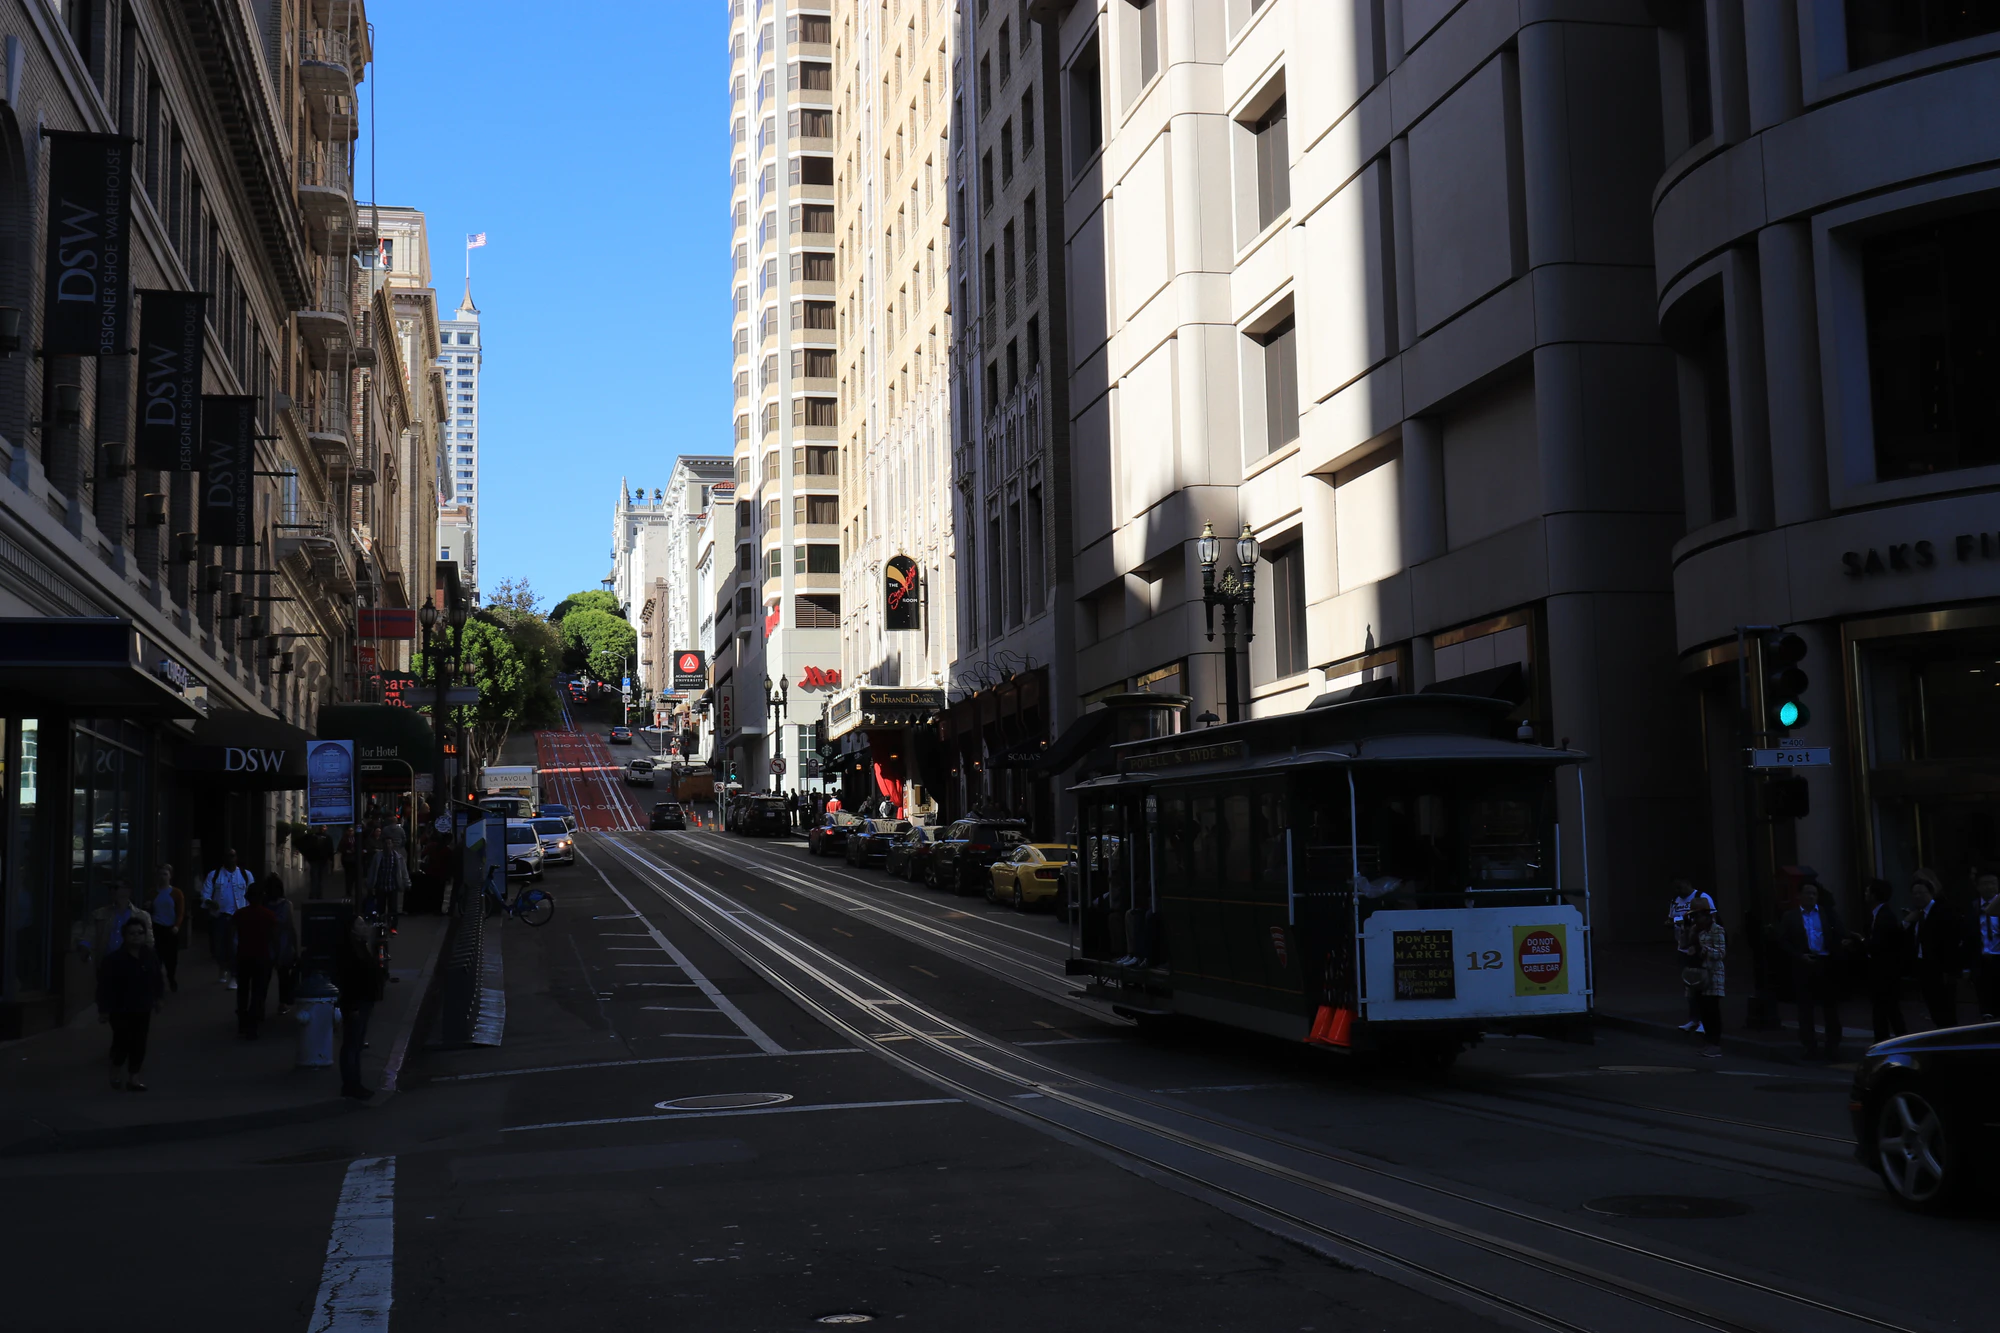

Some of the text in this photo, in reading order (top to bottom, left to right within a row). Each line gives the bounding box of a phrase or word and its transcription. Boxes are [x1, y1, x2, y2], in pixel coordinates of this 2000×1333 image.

[57, 198, 99, 304] DSW
[101, 148, 121, 355] DESIGNER SHOE WAREHOUSE
[145, 343, 178, 427] DSW
[181, 302, 197, 471] DESIGNER SHOE WAREHOUSE
[207, 440, 234, 508] DSW
[236, 404, 249, 545] DESIGNER SHOE WAREHOUSE
[1841, 531, 2000, 578] SAKS FI
[723, 696, 731, 727] PARK
[376, 745, 398, 757] Hotel
[1789, 739, 1804, 747] 400
[224, 747, 285, 773] DSW
[1007, 752, 1041, 760] SCALA'S
[1130, 756, 1169, 770] POWELL
[1189, 748, 1217, 761] HYDE
[1776, 752, 1810, 763] Post
[1396, 935, 1449, 944] POWELL
[1527, 937, 1554, 946] DO NOT
[1395, 950, 1450, 959] MARKET
[1467, 951, 1503, 970] 12
[1428, 969, 1453, 979] BEACH
[1523, 963, 1560, 973] CABLE CAR
